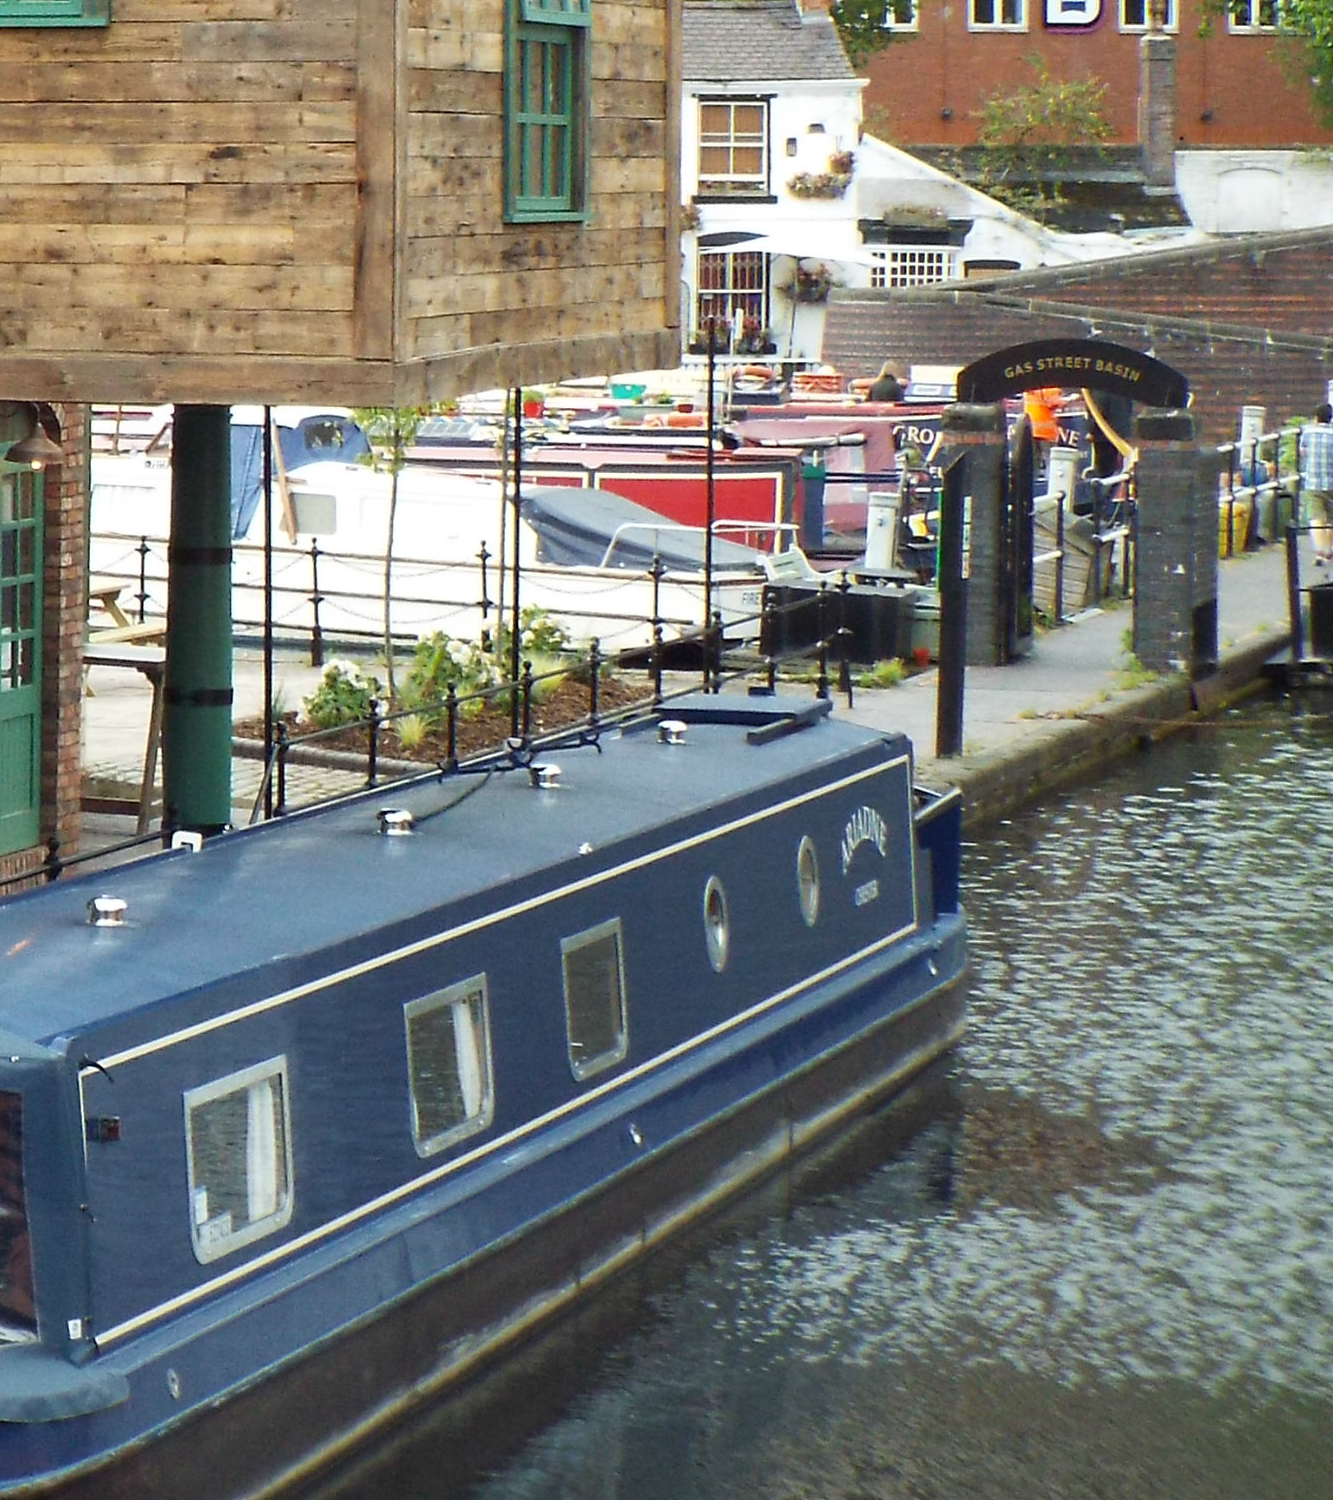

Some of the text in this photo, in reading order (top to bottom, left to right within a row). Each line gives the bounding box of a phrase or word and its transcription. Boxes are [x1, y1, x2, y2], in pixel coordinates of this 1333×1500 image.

[1004, 356, 1141, 382] GAS STREET BASIN
